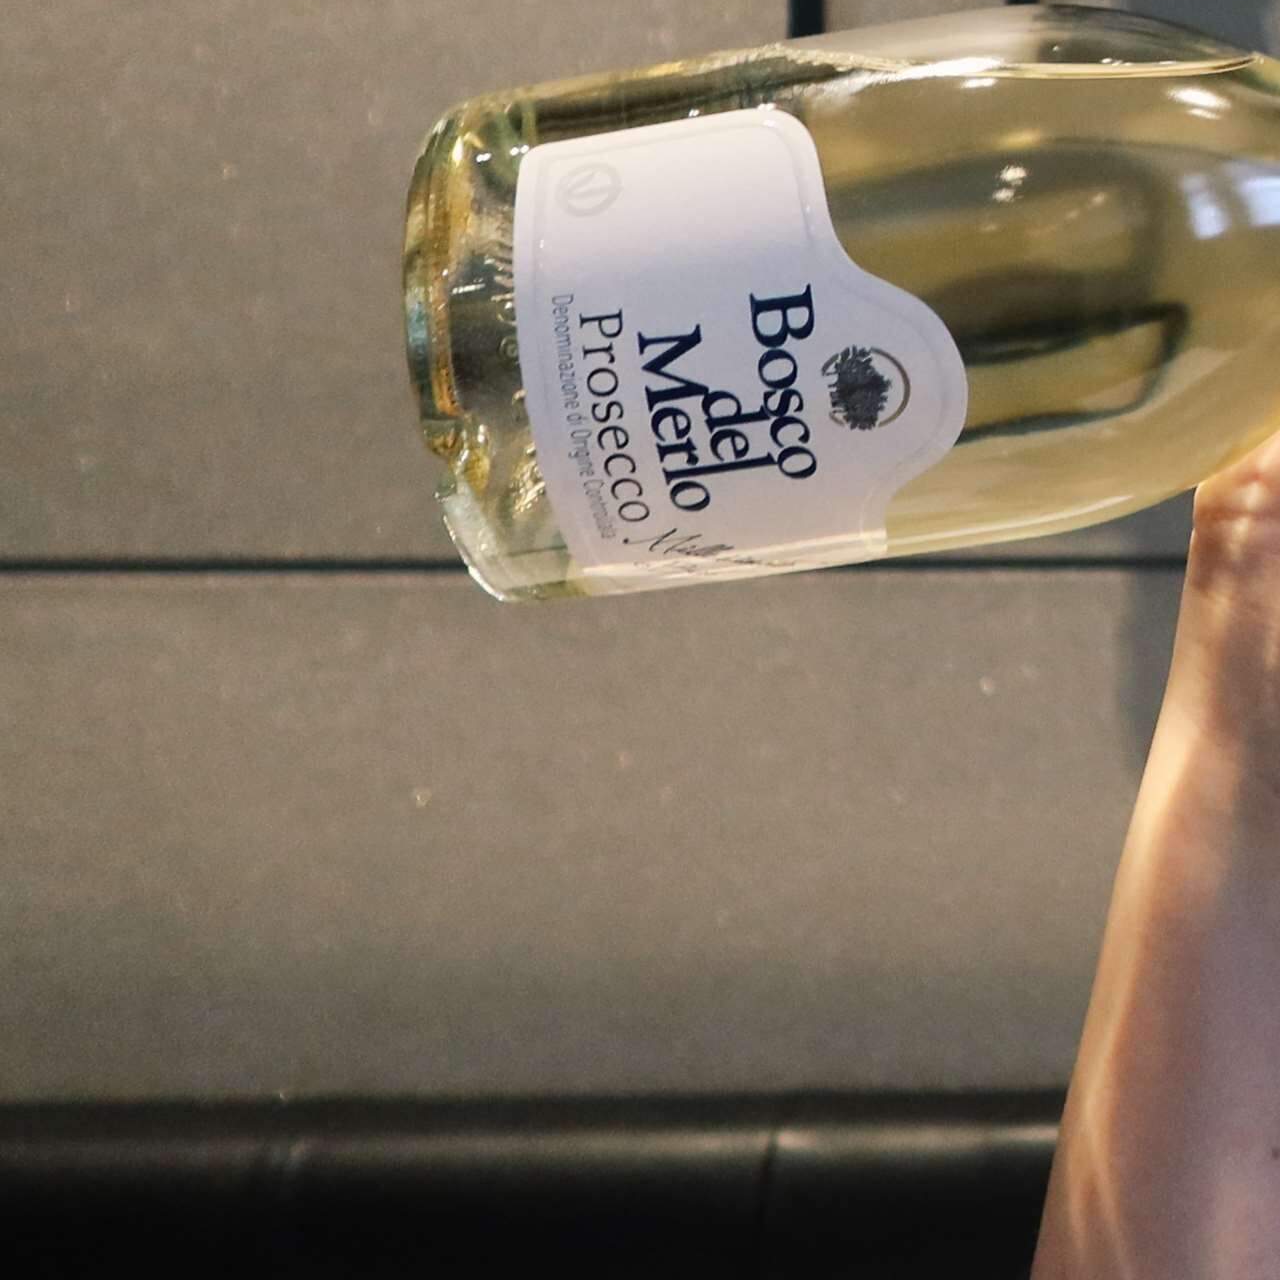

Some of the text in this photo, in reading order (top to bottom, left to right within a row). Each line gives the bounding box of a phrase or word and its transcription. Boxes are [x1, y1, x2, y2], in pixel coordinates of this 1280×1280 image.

[551, 294, 580, 410] Denominazione
[568, 429, 595, 477] Origine
[579, 308, 650, 523] Prosecco
[637, 323, 711, 512] Merlo
[701, 389, 779, 468] del
[750, 283, 817, 480] Bosco
